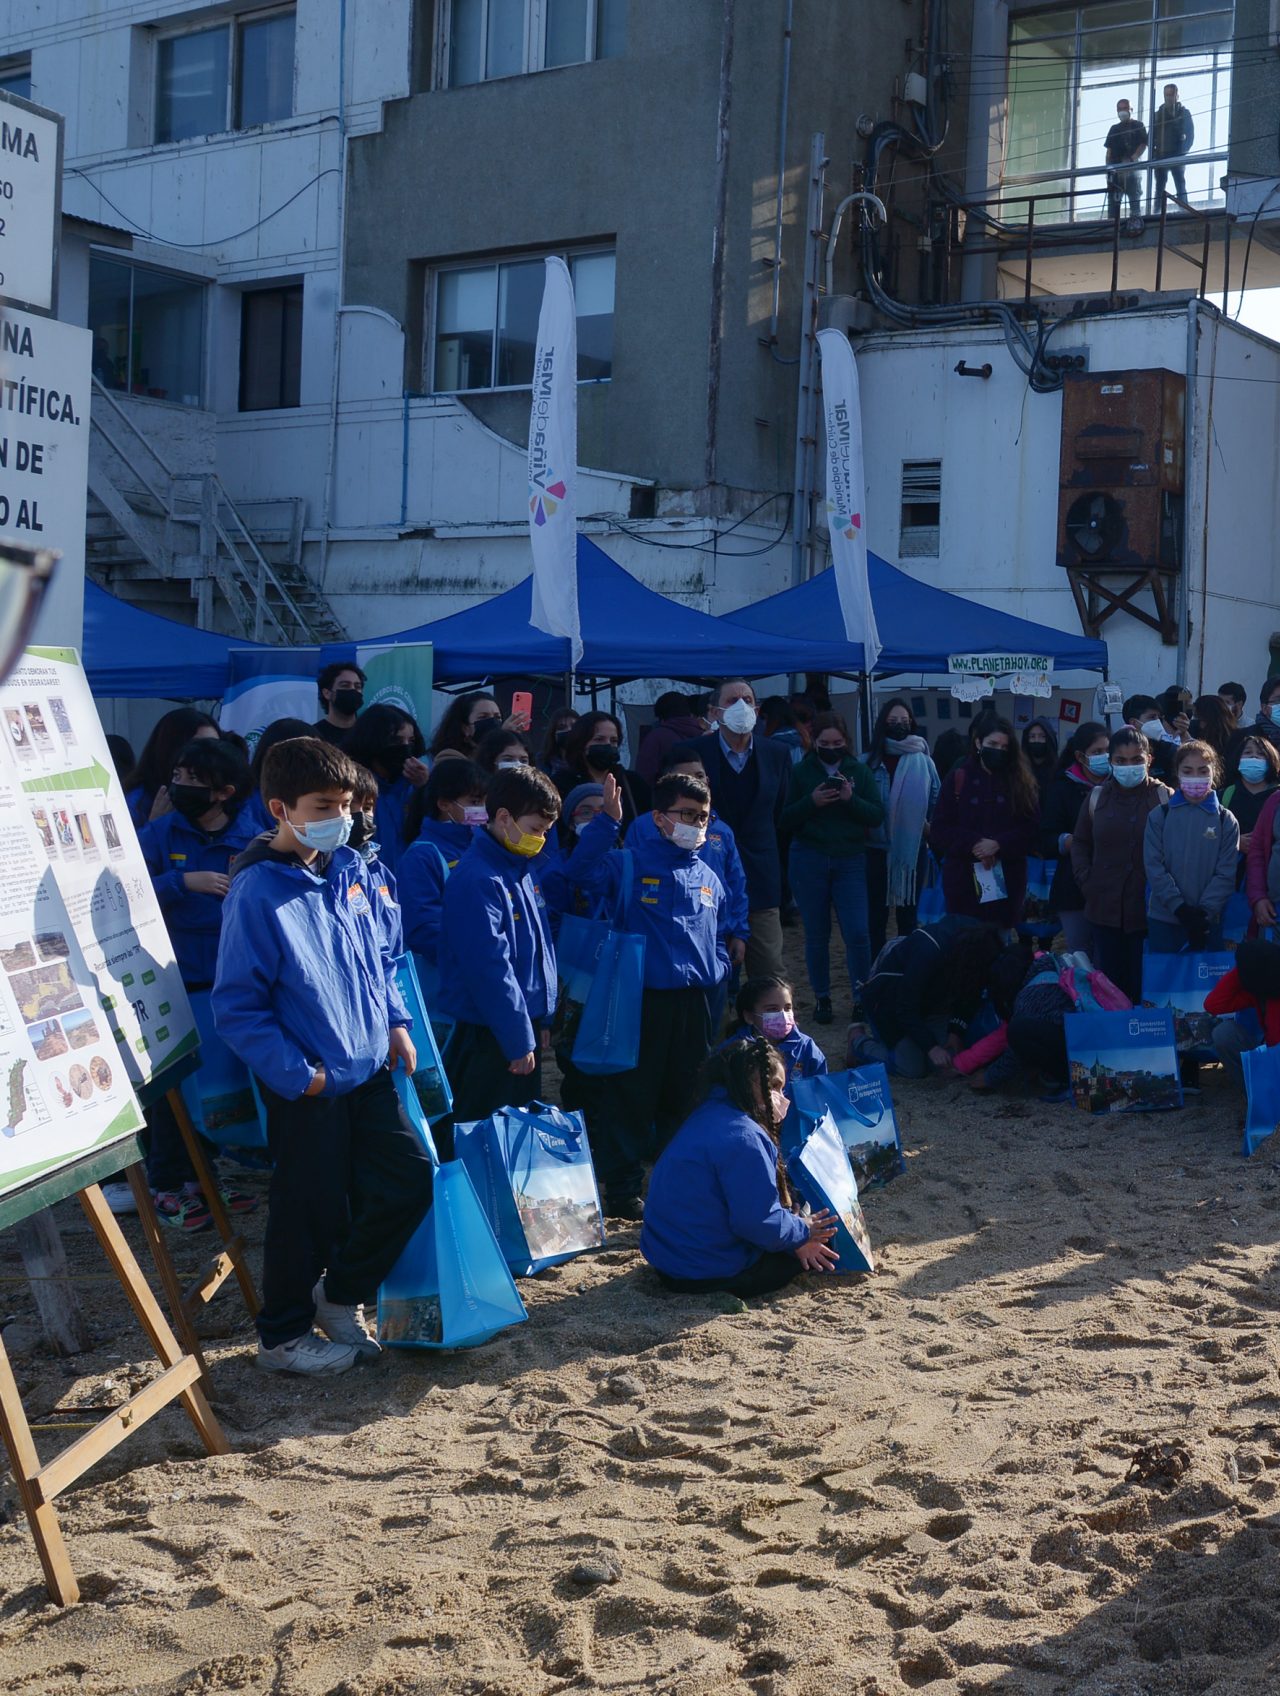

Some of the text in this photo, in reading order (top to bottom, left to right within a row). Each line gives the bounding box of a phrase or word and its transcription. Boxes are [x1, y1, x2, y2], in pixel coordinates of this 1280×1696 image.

[2, 121, 39, 163] MA
[16, 440, 43, 475] DE
[16, 499, 43, 532] AL
